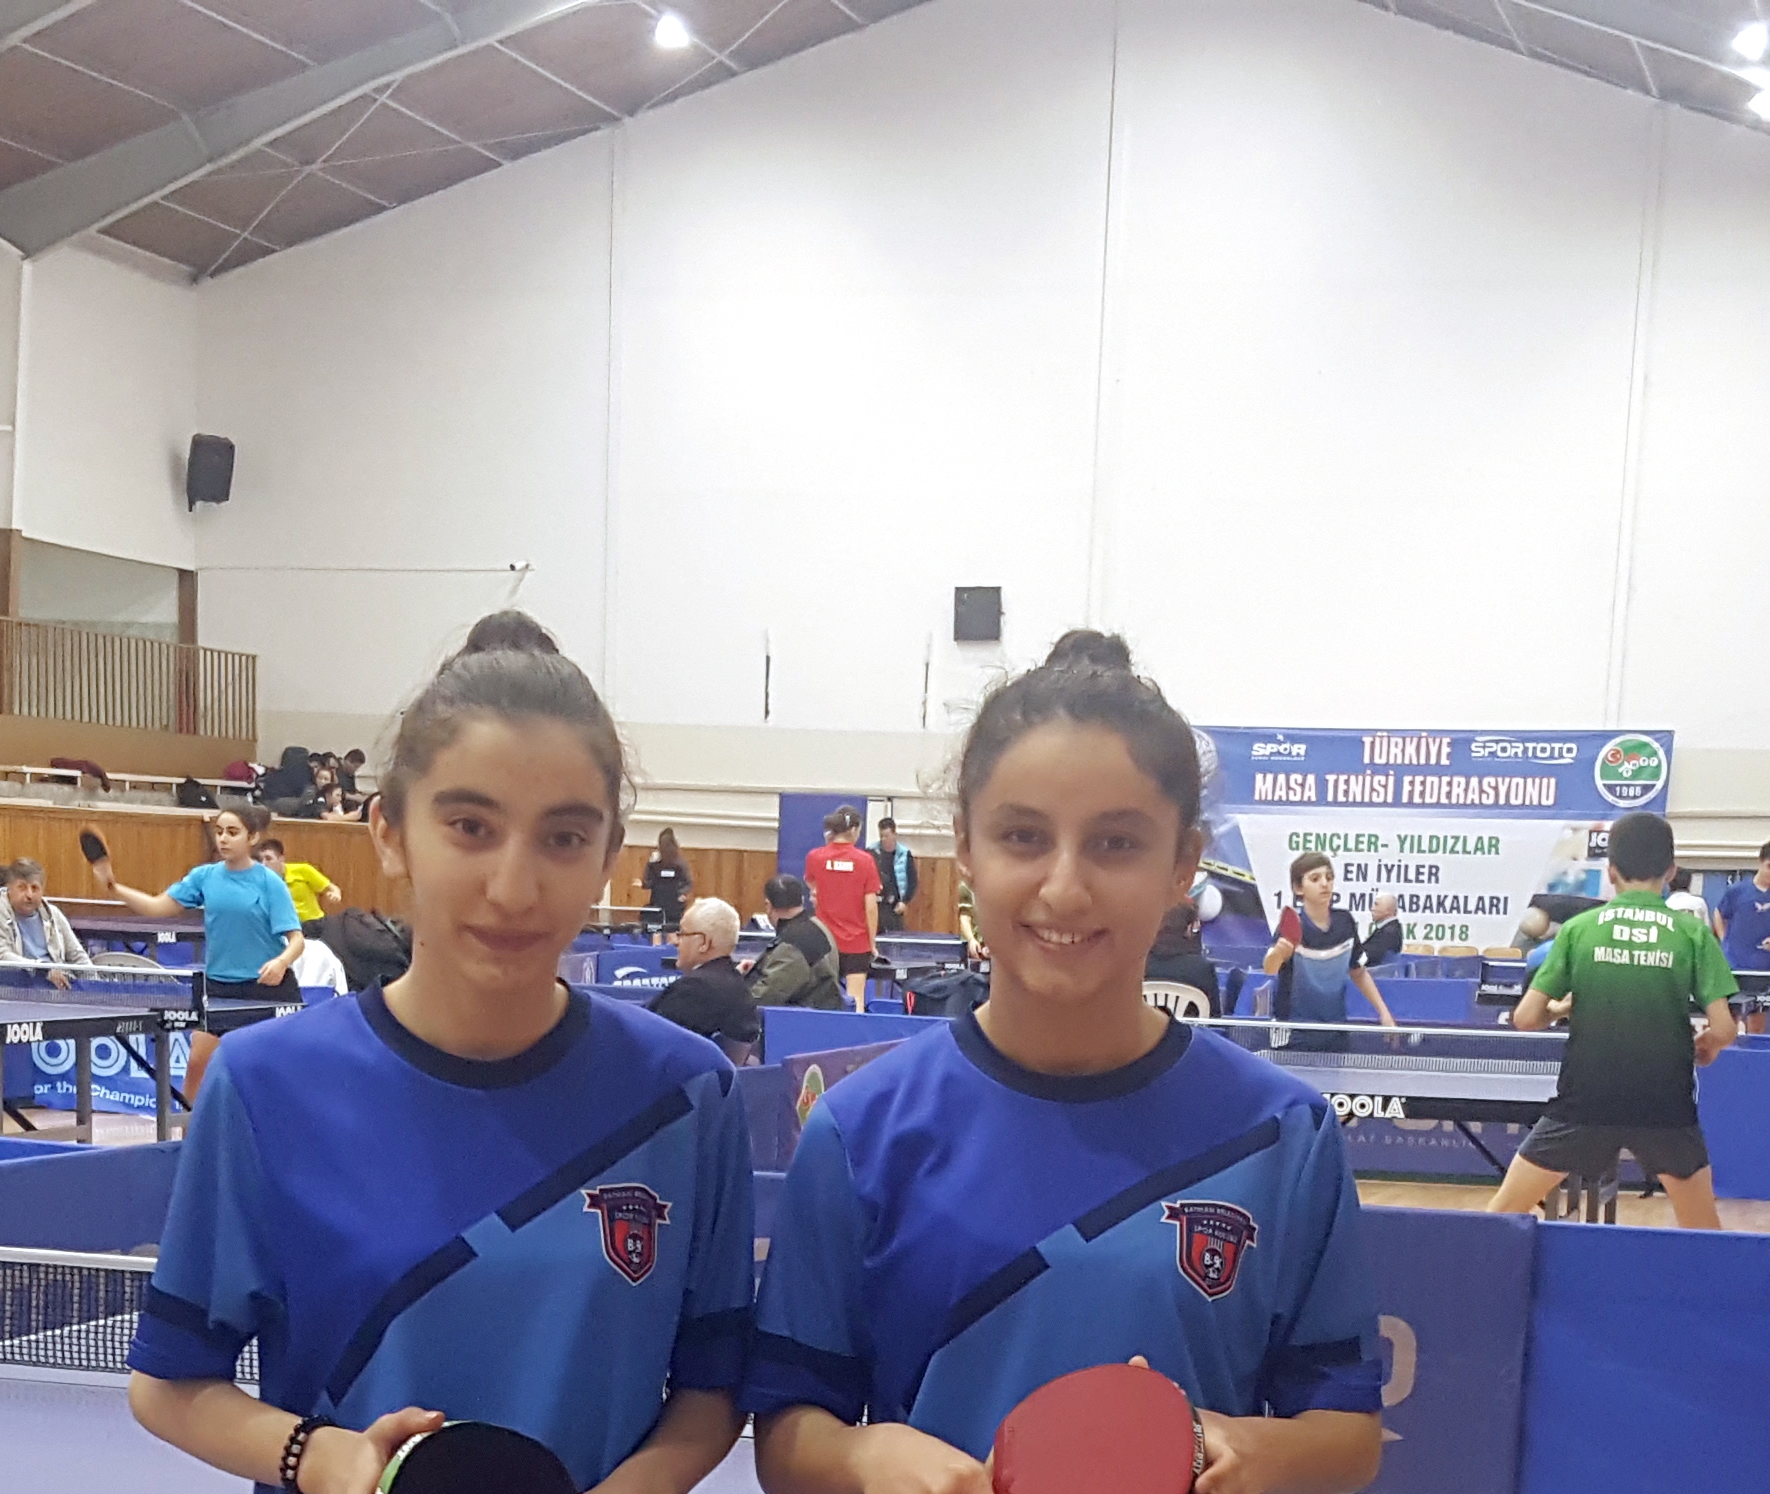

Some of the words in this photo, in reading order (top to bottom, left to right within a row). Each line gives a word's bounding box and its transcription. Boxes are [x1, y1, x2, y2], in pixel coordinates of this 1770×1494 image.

[1251, 742, 1307, 756] SPOR
[1362, 732, 1451, 765] TÜRKİYE
[1471, 741, 1577, 758] SPORTOTO
[1254, 772, 1317, 802] MASA
[1325, 769, 1395, 804] TENİSİ
[1401, 775, 1557, 807] FEDERASYONU
[1397, 833, 1500, 855] YILDIZLAR
[1342, 862, 1368, 883] EN
[1377, 859, 1440, 884] İYİLER
[1349, 888, 1509, 915] MÜABAKALARI
[1423, 923, 1469, 942] 2018
[1612, 925, 1658, 943] DSİ
[1594, 947, 1629, 965] MASA
[1632, 948, 1673, 968] TENİSİ
[164, 1010, 199, 1021] JOOLA
[6, 1022, 43, 1044] JOOLA
[31, 1032, 192, 1078] OOLA
[90, 1084, 157, 1107] Champio
